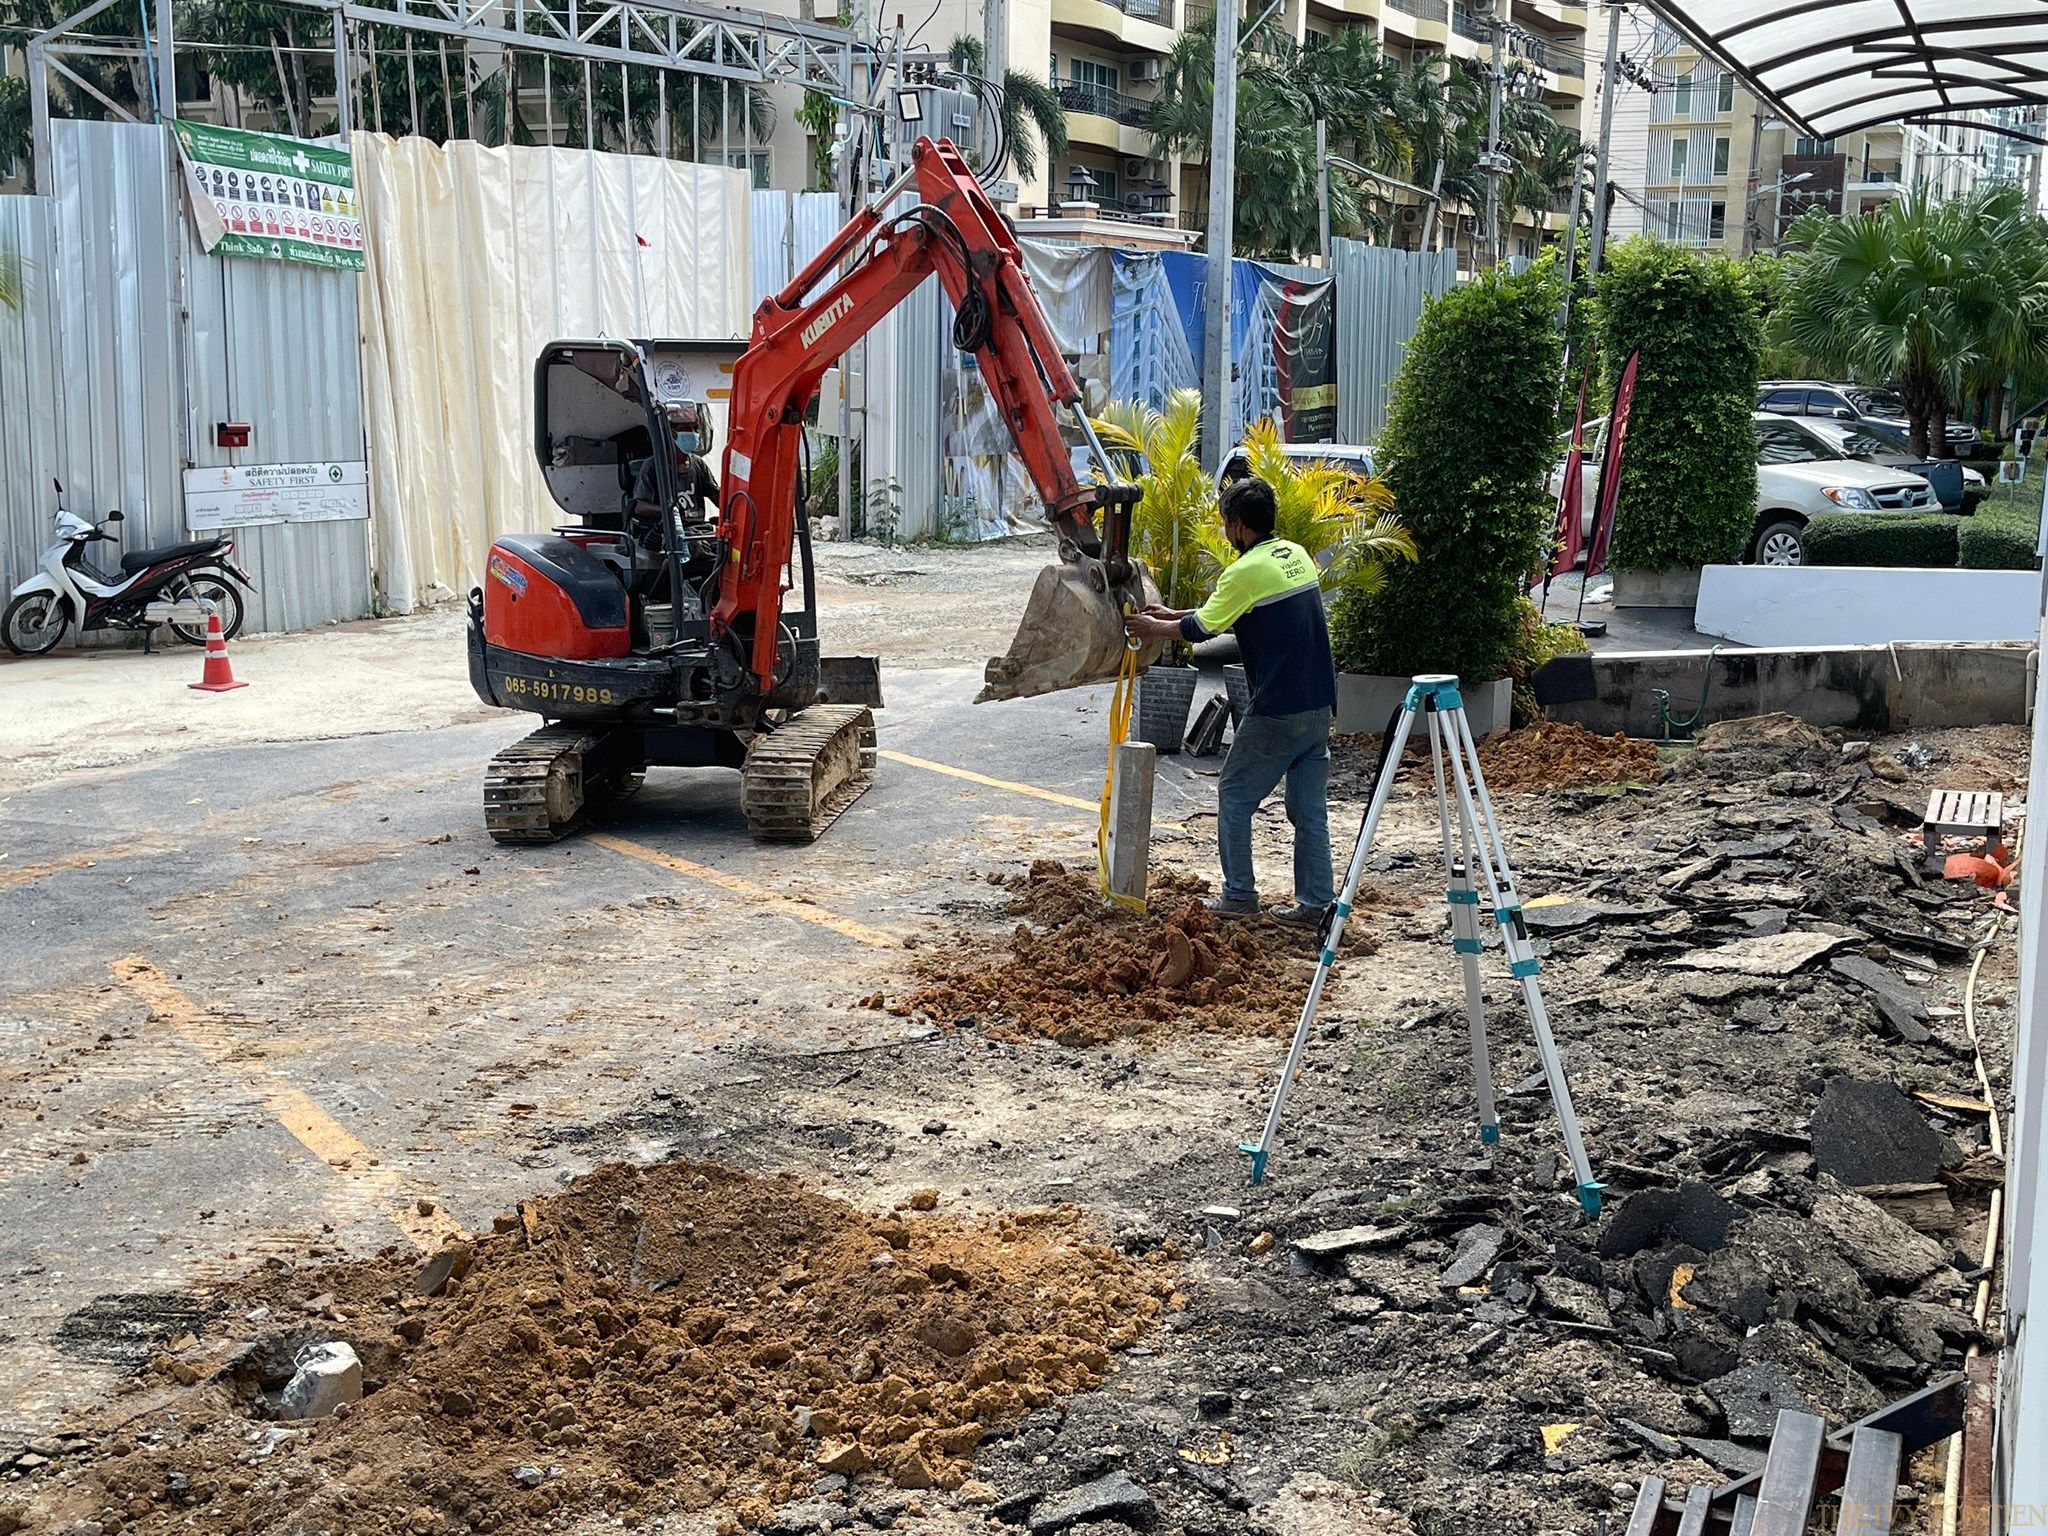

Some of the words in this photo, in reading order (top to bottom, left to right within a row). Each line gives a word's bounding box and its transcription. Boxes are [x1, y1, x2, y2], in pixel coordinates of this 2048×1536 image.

[311, 159, 336, 177] SAFETY
[220, 241, 244, 253] Think
[246, 243, 265, 254] Safe
[335, 254, 353, 267] Work
[354, 257, 365, 267] Sa
[800, 292, 855, 350] KUBOTA
[244, 465, 318, 477] สถิติความปลอดภัย
[249, 477, 285, 487] SAFETY
[290, 476, 316, 485] FIRST
[1280, 559, 1302, 570] vision
[1285, 566, 1306, 579] ZERO
[505, 675, 612, 705] 065-5917989
